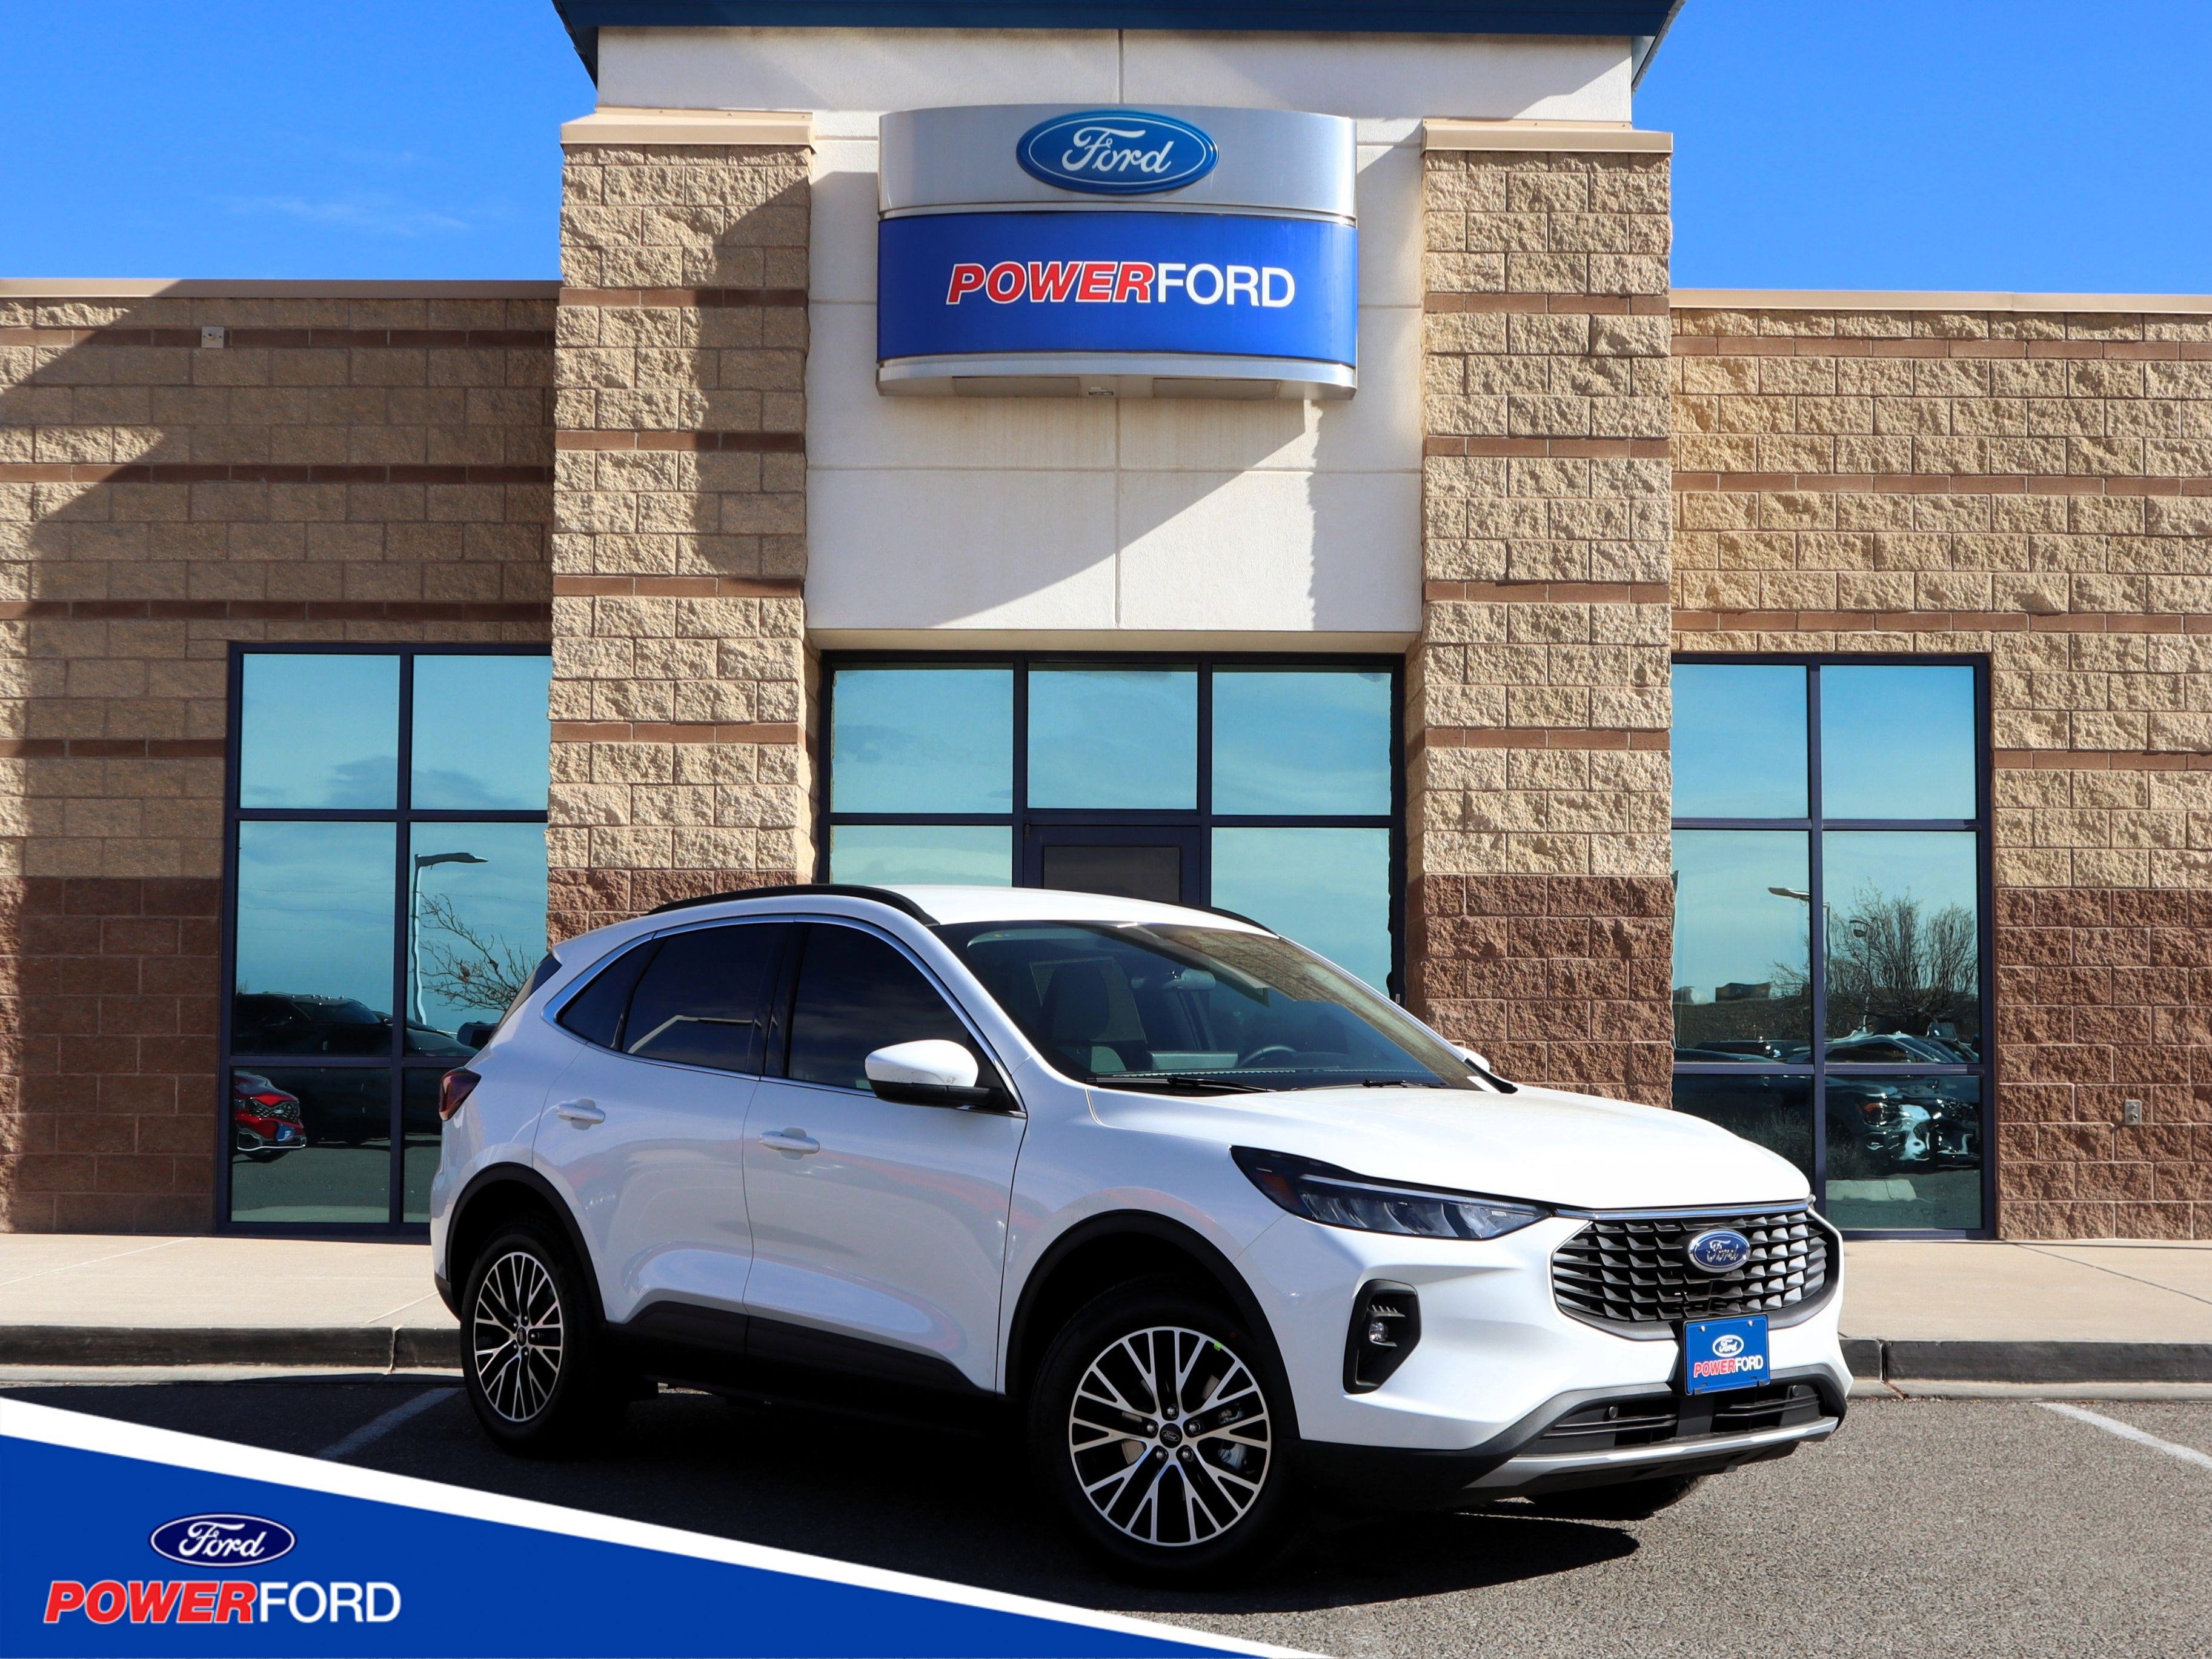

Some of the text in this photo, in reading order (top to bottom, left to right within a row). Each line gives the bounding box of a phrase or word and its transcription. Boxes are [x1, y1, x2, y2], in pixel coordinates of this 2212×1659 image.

[1061, 126, 1175, 173] Ford
[945, 261, 1296, 307] POWERFORD
[1706, 1240, 1739, 1263] Ford
[1718, 1338, 1738, 1352] Ford
[1693, 1355, 1764, 1378] POWERFORD
